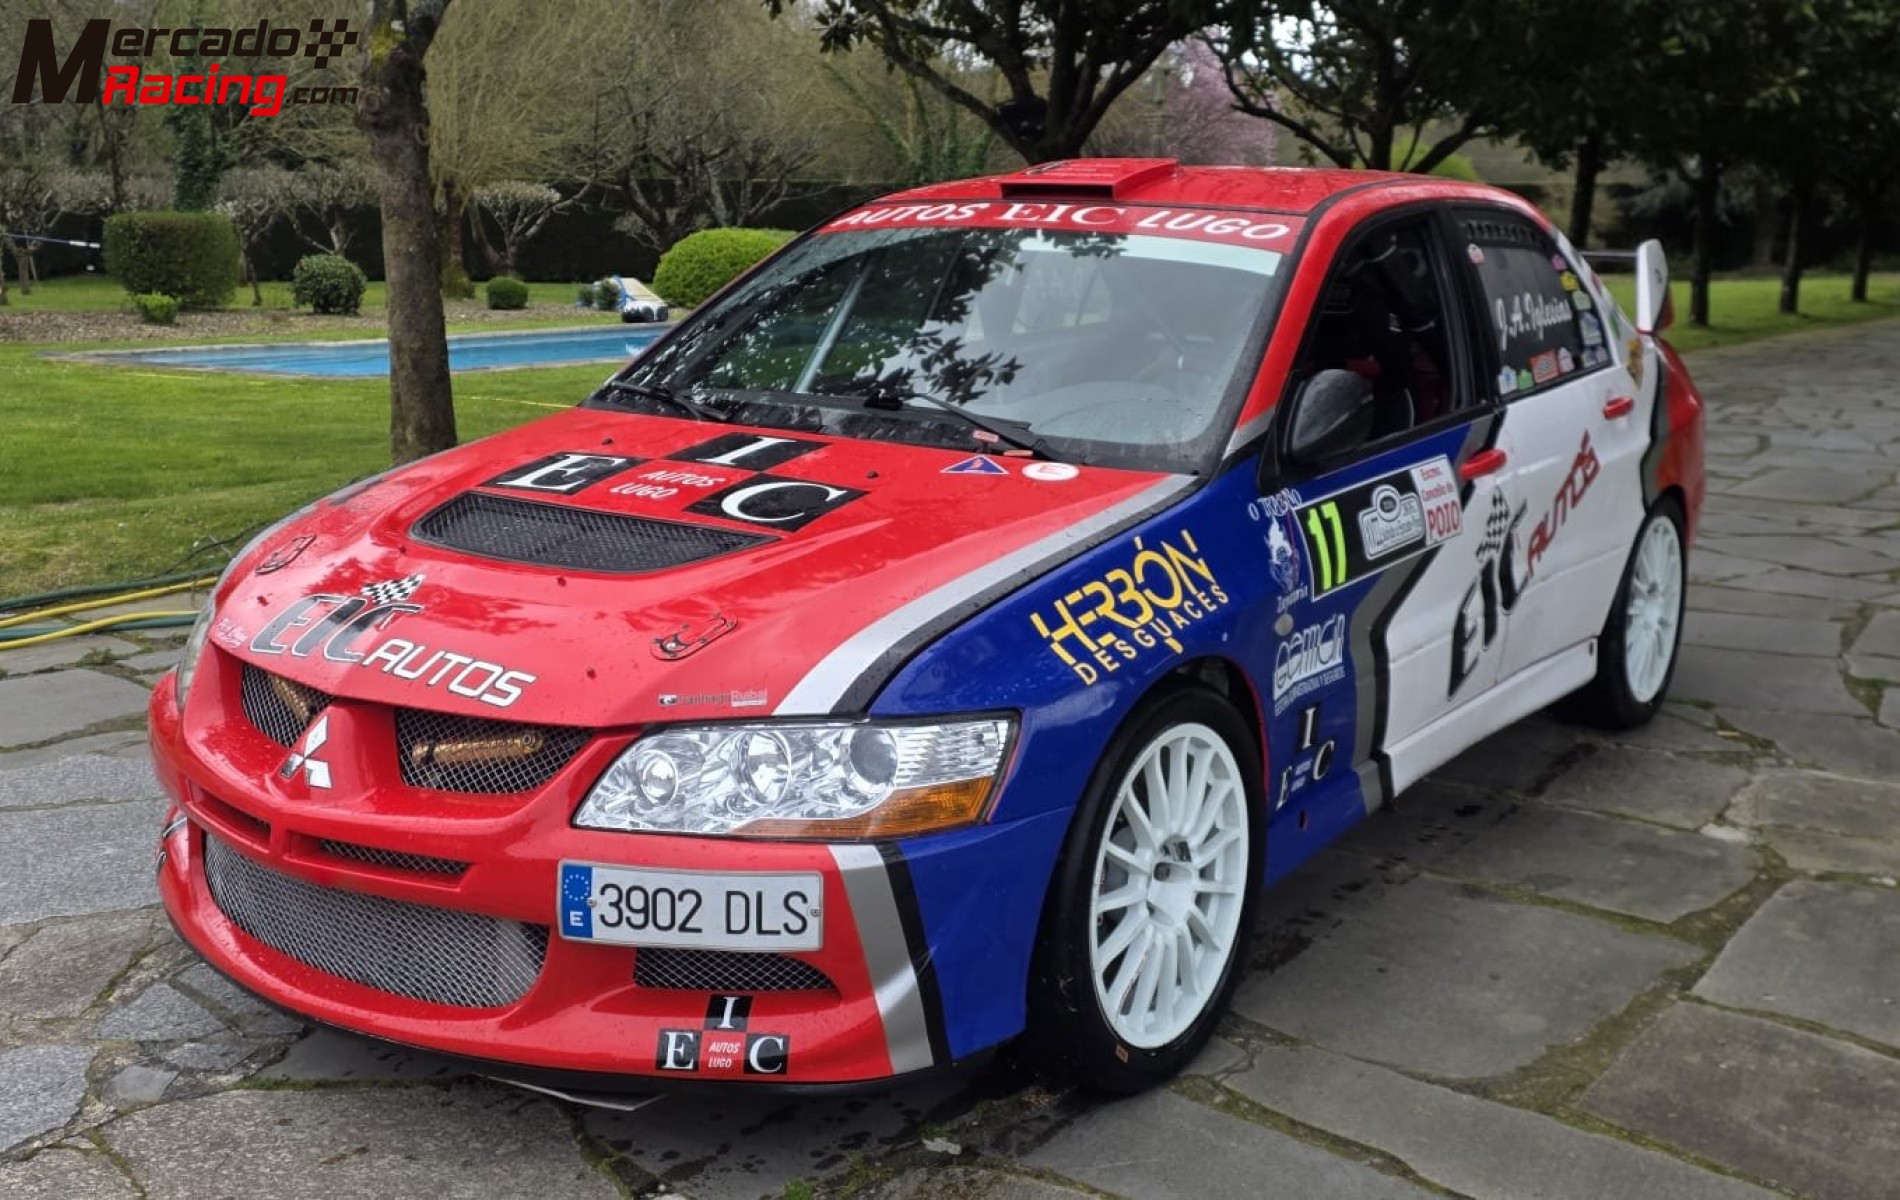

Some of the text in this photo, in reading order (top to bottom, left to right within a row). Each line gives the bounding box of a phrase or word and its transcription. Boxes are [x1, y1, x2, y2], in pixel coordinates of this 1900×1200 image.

[830, 202, 1290, 241] AUTOS EIC LUGO
[610, 483, 680, 500] LUGO
[638, 469, 727, 488] AUTOS
[1427, 500, 1461, 541] POIO
[1073, 584, 1230, 686] DESGUACES
[362, 638, 537, 707] AUTOS
[569, 911, 584, 927] E
[599, 883, 809, 936] 3902 DLS
[708, 1041, 741, 1053] AUTOS
[708, 1058, 732, 1068] LUGO
